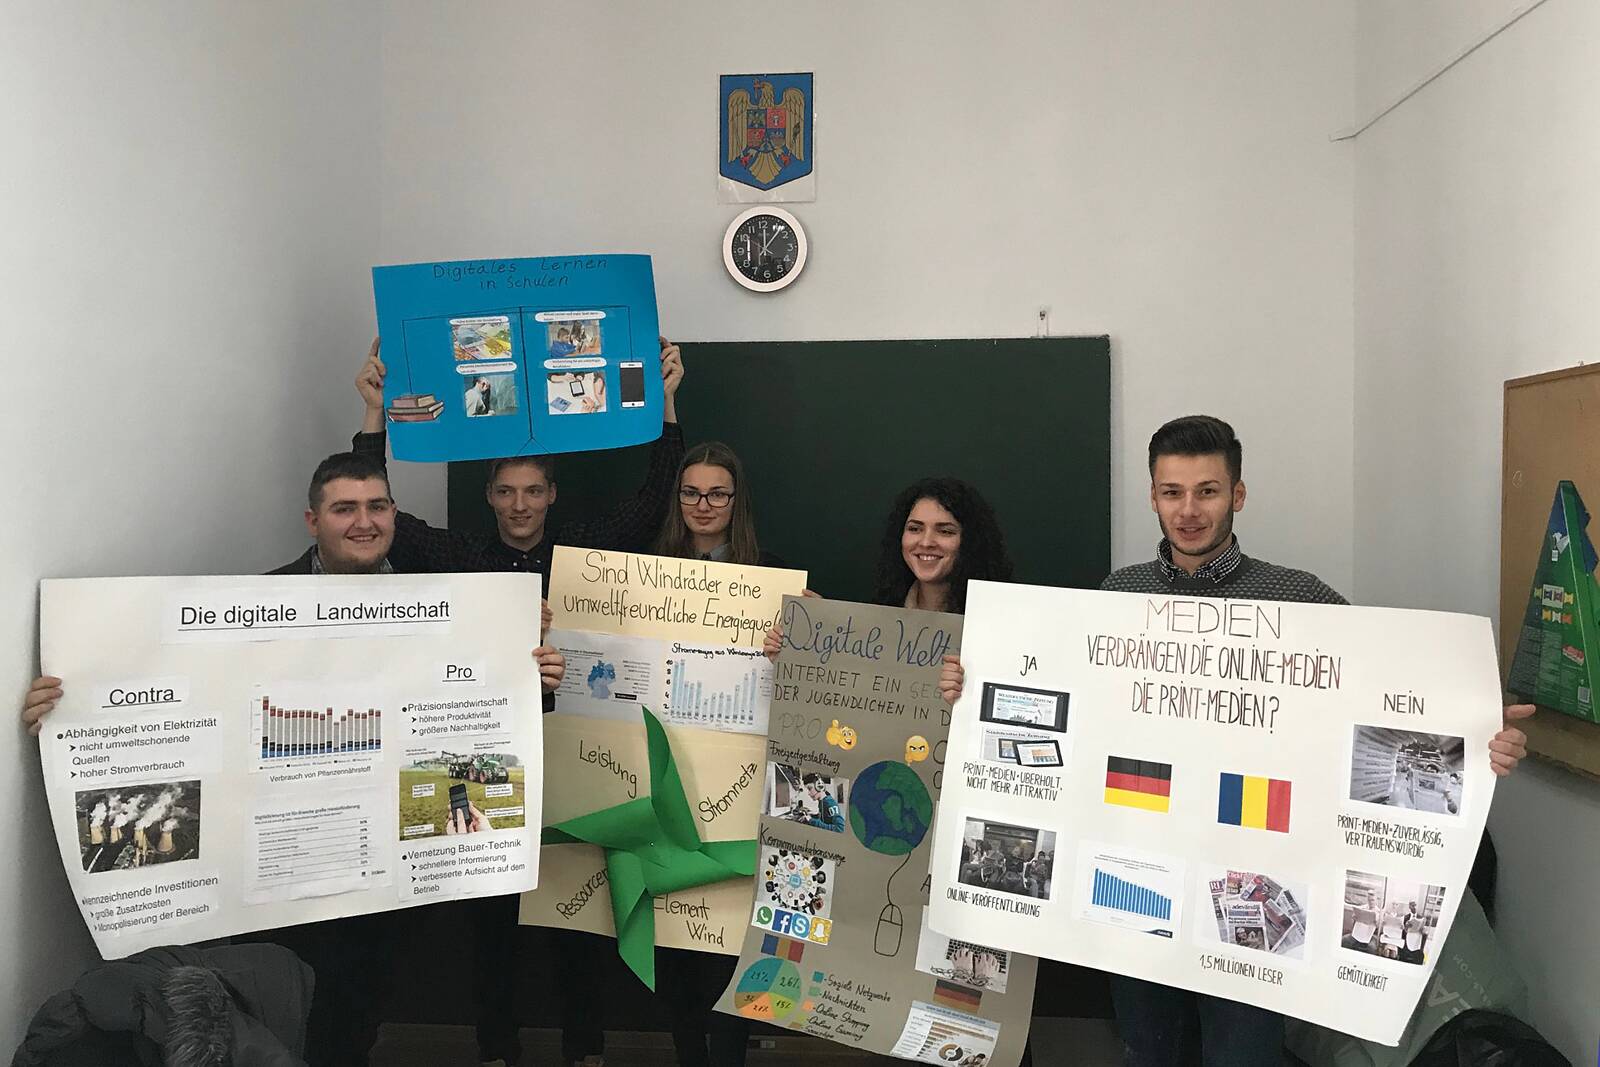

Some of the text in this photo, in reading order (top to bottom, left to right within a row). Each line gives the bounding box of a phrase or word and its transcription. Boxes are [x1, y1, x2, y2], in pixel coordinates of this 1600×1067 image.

[748, 226, 755, 234] 11
[759, 220, 768, 229] 12
[782, 231, 789, 239] 2
[783, 254, 791, 262] 4
[434, 258, 607, 282] Digitales Lernen
[752, 267, 758, 275] 7
[764, 270, 771, 278] 6
[480, 275, 569, 290] in Schulen
[582, 551, 762, 599] Sind Windräder eine
[181, 601, 450, 627] Die digitale Landwirtschaft
[563, 589, 697, 625] umweltfreundliche
[1146, 598, 1281, 640] MEDIEN
[781, 600, 951, 667] Digitale Welt
[1020, 655, 1038, 677] JA
[1087, 633, 1342, 690] VERDRÄNGEN DIE ONLINE-MEDIEN
[446, 664, 473, 679] Pro
[776, 661, 861, 689] INTERNET
[872, 675, 901, 693] EIN
[910, 681, 943, 700] SEG
[109, 687, 174, 706] Contra
[408, 698, 508, 712] Präzisionslandwirtschaft
[774, 683, 800, 701] DER
[805, 689, 905, 715] JUGENDLICHEN
[913, 705, 929, 720] IN
[1132, 677, 1280, 734] DIE PRINT-MEDIEN?
[1383, 690, 1425, 716] NEIN
[419, 711, 491, 723] höhere Produktivität
[779, 712, 822, 739] PRO
[65, 718, 216, 740] Abhängigkeit von Elektrizität
[419, 721, 501, 736] größere Nachhaltigkeit
[79, 734, 190, 752] nicht umweltschonende
[72, 755, 110, 766] Quellen
[80, 760, 185, 779] hoher Stromverbrauch
[580, 740, 637, 799] Leistung
[269, 772, 303, 783] Verbrauch
[304, 771, 316, 779] von
[966, 776, 1059, 802] NICHT MEHR ATTRAKTIV
[828, 805, 839, 817] 07
[408, 839, 522, 860] Vernetzung Bauer-Technik
[419, 853, 507, 871] schnellere Informierung
[419, 863, 525, 882] verbesserte Aufsicht auf dem
[155, 876, 218, 894] Investitionen
[413, 884, 440, 895] Betrieb
[116, 898, 171, 916] Zusatzkosten
[159, 911, 174, 921] der
[176, 904, 209, 918] Bereich
[686, 920, 724, 948] Wind
[1213, 955, 1256, 979] MILLIONEN
[1257, 967, 1284, 986] LESER
[1337, 965, 1389, 992] GEMÜTLICHKEIT
